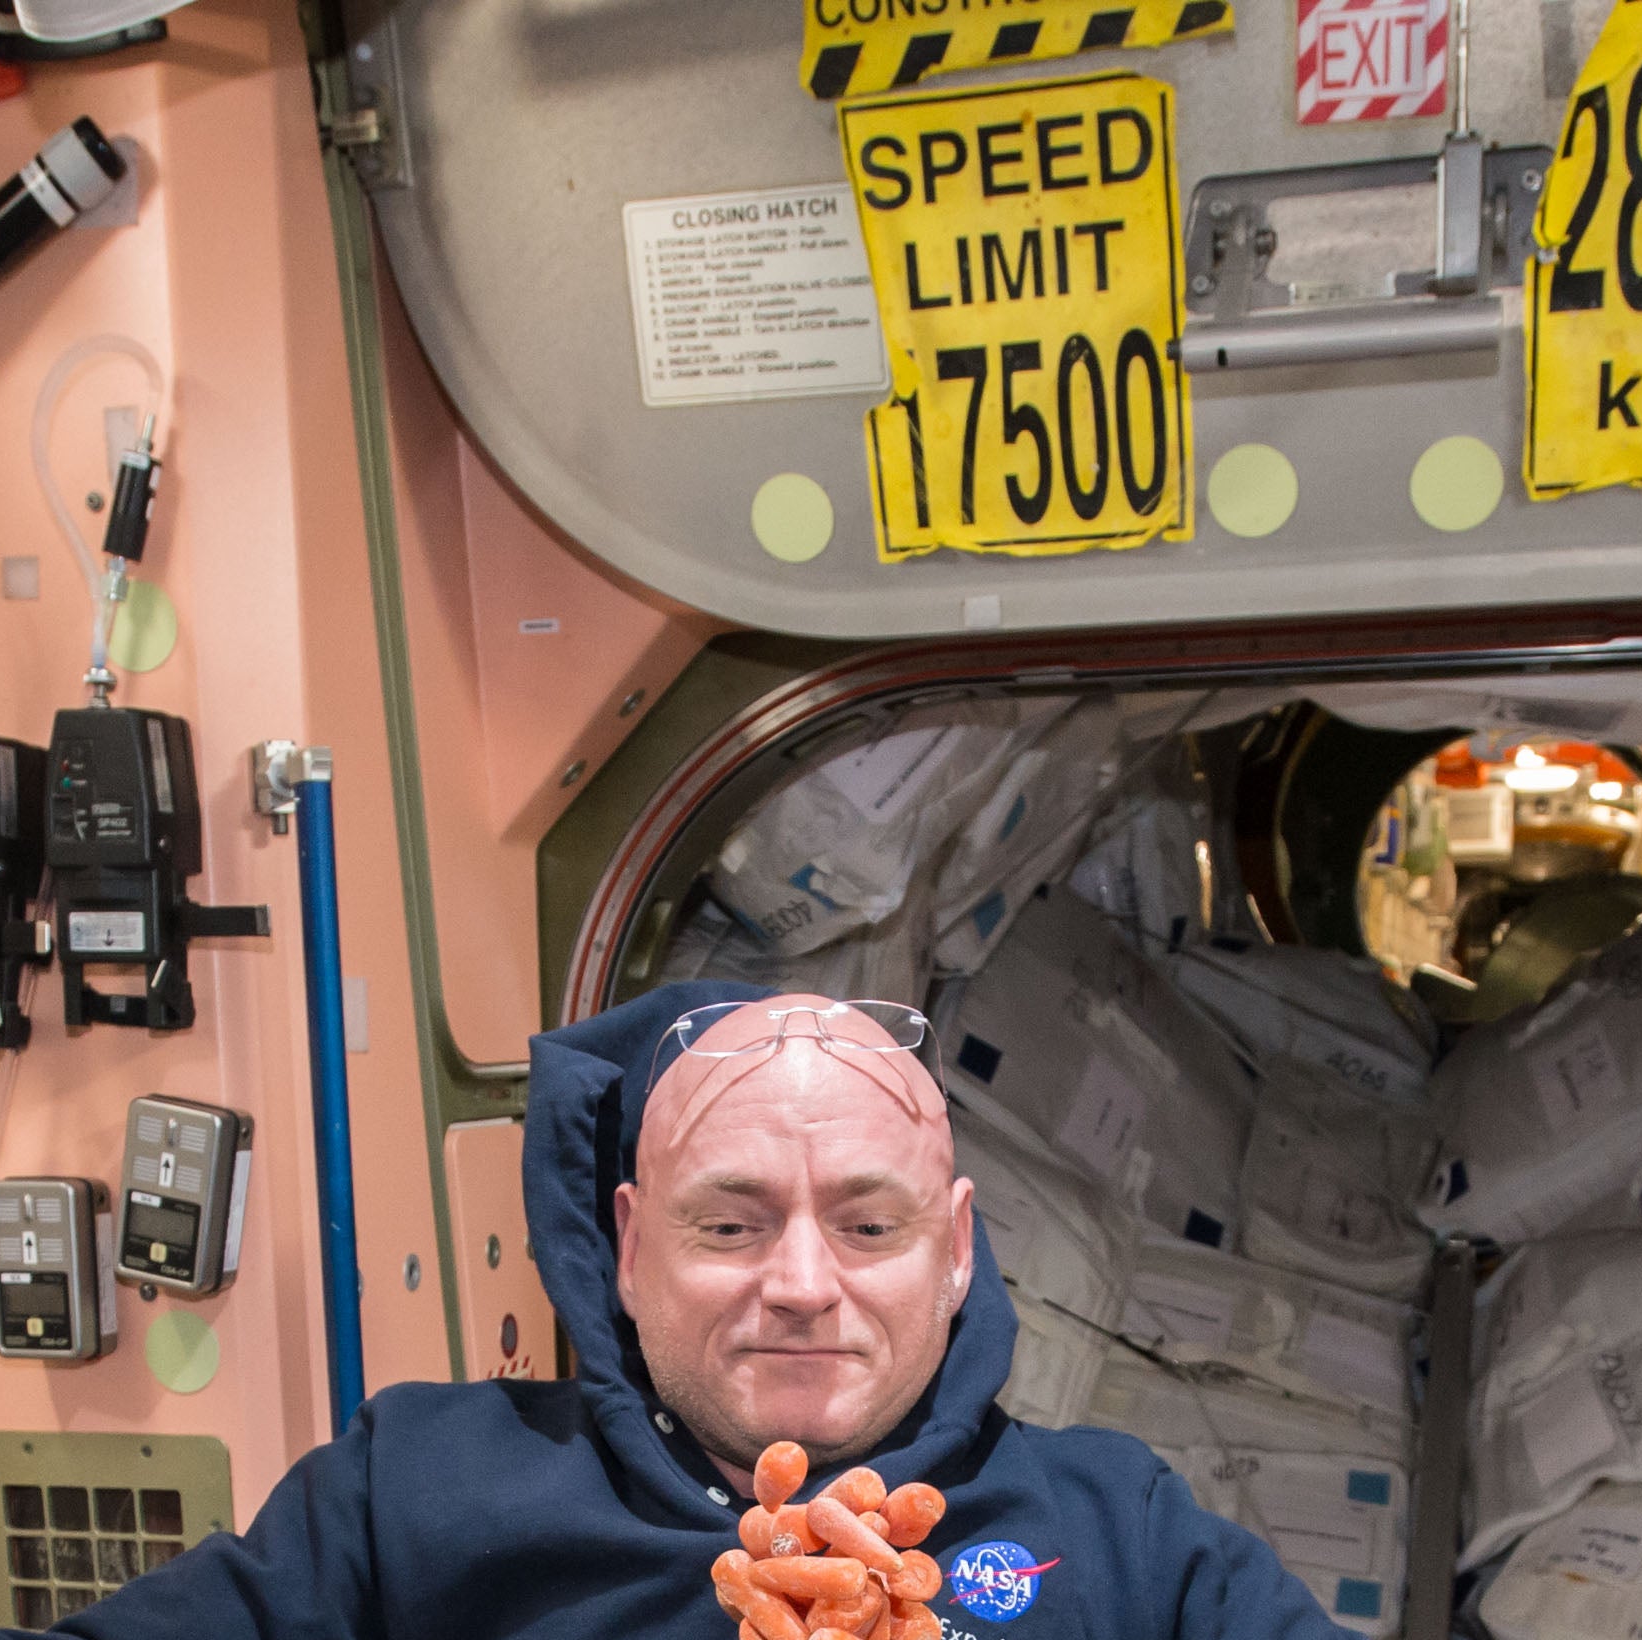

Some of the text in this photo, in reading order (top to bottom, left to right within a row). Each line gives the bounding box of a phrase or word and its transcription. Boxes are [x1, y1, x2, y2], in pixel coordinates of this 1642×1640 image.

[1320, 14, 1423, 91] EXIT
[860, 107, 1154, 211] SPEED
[673, 198, 837, 229] CLOSING HATCH
[904, 220, 1125, 311] LIMIT
[897, 328, 1167, 529] 17500
[955, 1559, 1032, 1599] NASA
